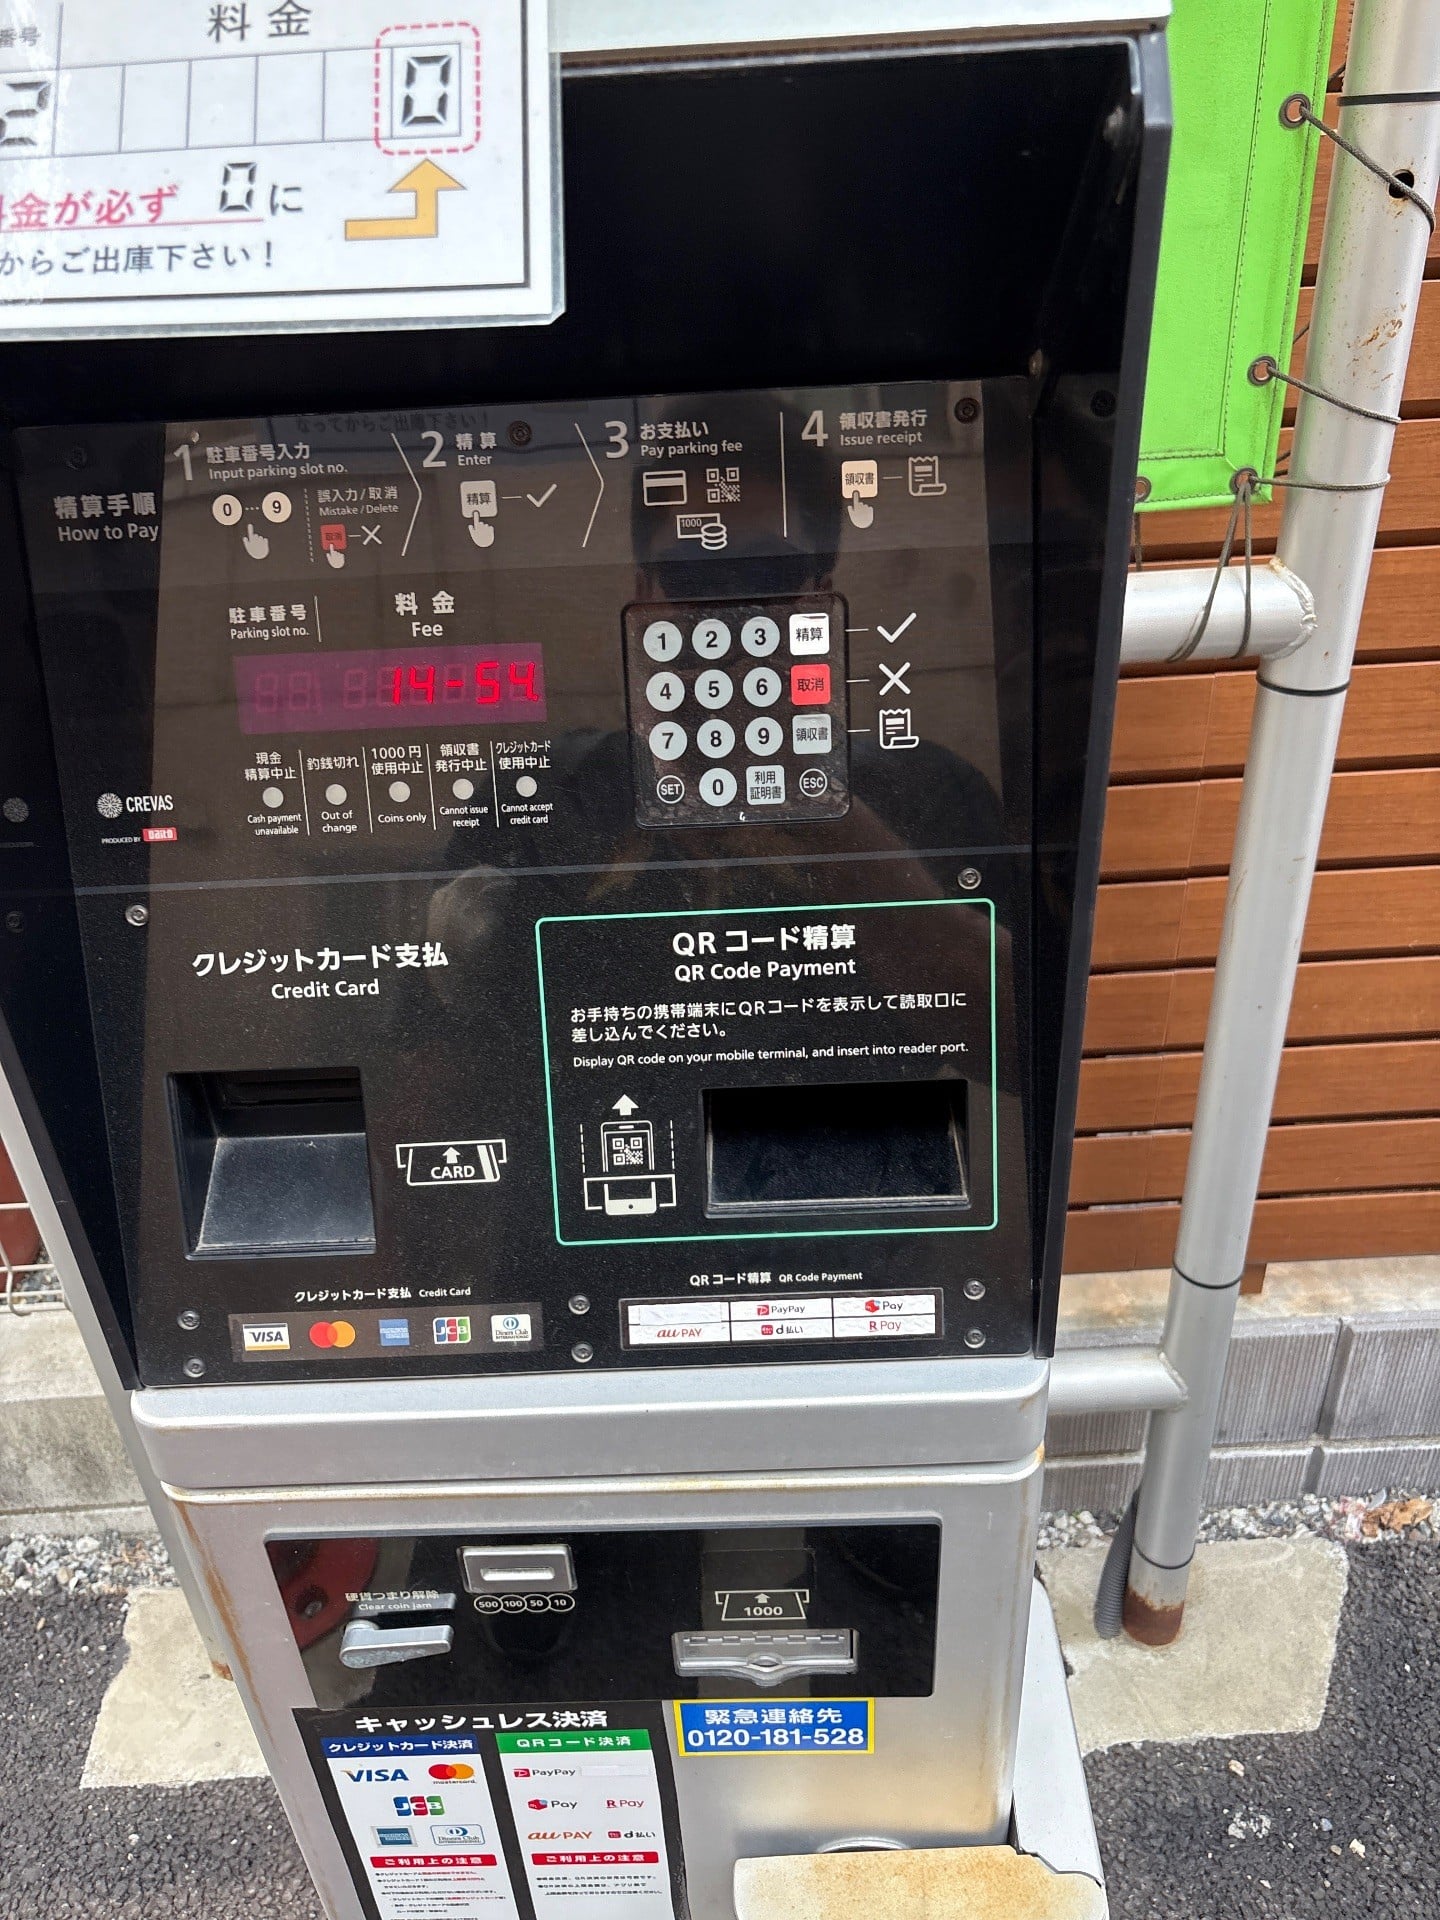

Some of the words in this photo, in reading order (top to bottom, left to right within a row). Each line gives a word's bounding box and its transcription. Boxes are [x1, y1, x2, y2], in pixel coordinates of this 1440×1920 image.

[207, 0, 313, 43] 料金
[401, 55, 452, 125] 0
[0, 81, 52, 146] 2
[0, 184, 179, 229] 金が必ず
[840, 410, 928, 430] 領収書発行
[640, 421, 709, 441] お支払い
[801, 410, 828, 448] 4
[456, 432, 497, 450] 精算
[604, 420, 629, 459] 3
[840, 434, 872, 447] Issue
[873, 431, 922, 447] receipt
[206, 442, 310, 463] 駐車番号入力
[421, 431, 447, 468] 2
[641, 443, 664, 458] Pay
[667, 441, 719, 458] parking
[721, 440, 743, 453] fee
[173, 444, 193, 481] 1
[458, 454, 492, 466] Enter
[209, 467, 244, 481] Input
[247, 465, 296, 480] parking
[300, 463, 324, 475] slot
[327, 463, 348, 473] no.
[844, 471, 875, 486] 領収書
[54, 492, 157, 519] 精算手順
[466, 492, 492, 505] 精算
[223, 503, 232, 516] 0
[272, 500, 281, 514] 9
[680, 518, 702, 528] 1000
[58, 526, 99, 542] How
[104, 524, 122, 540] to
[128, 523, 159, 542] Pay
[395, 590, 455, 617] 料金
[229, 604, 307, 625] 駐車番号
[230, 627, 269, 640] Parking
[271, 626, 291, 638] slot
[293, 626, 309, 637] no.
[412, 622, 443, 638] Fee
[754, 629, 766, 645] 3
[795, 627, 824, 641] 精算
[657, 633, 666, 650] 1
[705, 631, 718, 648] 2
[659, 683, 671, 700] 4
[708, 681, 720, 698] 5
[756, 679, 768, 695] 6
[796, 678, 824, 692] 取消
[661, 733, 673, 749] 7
[710, 731, 722, 748] 8
[758, 728, 770, 745] 9
[796, 727, 829, 742] 領収書
[440, 743, 479, 757] 領収書
[495, 740, 551, 754] クレジットカード
[256, 751, 282, 765] 現金
[307, 756, 360, 771] 釣銭切れ
[435, 758, 487, 773] 発行中止
[498, 755, 551, 770] 使用中止
[245, 766, 297, 781] 精算中止
[372, 760, 424, 775] 使用中止
[754, 771, 776, 784] 利用
[803, 777, 824, 789] ESC
[660, 784, 681, 796] SET
[712, 779, 724, 795] 0
[750, 787, 782, 800] 証明書
[126, 795, 173, 812] CREVAS
[440, 805, 466, 815] Cannot
[468, 804, 488, 814] issue
[501, 803, 528, 813] Cannot
[529, 802, 553, 813] accept
[247, 814, 266, 825] Cash
[268, 813, 302, 826] payment
[321, 811, 341, 821] Out
[343, 810, 353, 821] of
[378, 813, 403, 823] Coins
[405, 812, 427, 825] only
[452, 817, 480, 828] receipt
[510, 815, 531, 825] credit
[533, 814, 548, 824] card
[255, 825, 299, 836] unavailable
[322, 823, 357, 835] change
[192, 942, 449, 977] クレジットカード支払
[674, 965, 705, 982] QR
[710, 961, 761, 981] Code
[767, 958, 856, 981] Payment
[271, 980, 330, 999] Credit
[334, 978, 379, 997] Card
[570, 991, 967, 1024] お手持ちの携帯端末にQRコードを表示して読取口に
[571, 1021, 727, 1043] 差し込んでください。
[573, 1055, 614, 1069] Display
[617, 1053, 635, 1066] QR
[637, 1052, 666, 1064] code
[668, 1053, 683, 1064] on
[686, 1052, 713, 1065] your
[716, 1047, 755, 1061] mobile
[757, 1046, 809, 1061] terminal,
[811, 1044, 834, 1057] and
[837, 1043, 869, 1056] insert
[872, 1043, 895, 1055] into
[898, 1042, 936, 1055] reader
[940, 1041, 969, 1055] port.
[431, 1165, 475, 1179] CARD
[778, 1273, 794, 1283] QR
[795, 1272, 820, 1283] Code
[822, 1271, 863, 1282] Payment
[294, 1287, 411, 1303] クレジットカード支払
[419, 1287, 447, 1298] Credit
[449, 1286, 471, 1297] Card
[771, 1304, 805, 1315] PayPay
[883, 1300, 903, 1312] Pay
[434, 1321, 469, 1339] JCB
[657, 1328, 680, 1338] au
[682, 1328, 702, 1337] PAY
[869, 1321, 877, 1332] R
[880, 1320, 902, 1332] Pay
[249, 1330, 283, 1343] VISA
[358, 1603, 385, 1611] Clear
[388, 1602, 410, 1610] coin
[412, 1601, 432, 1611] jam
[479, 1601, 499, 1609] 500
[504, 1600, 523, 1608] 100
[530, 1599, 543, 1608] 50
[553, 1598, 566, 1607] 10
[743, 1606, 783, 1617] 1000
[355, 1710, 608, 1734] キャッシュレス決済
[705, 1708, 842, 1725] 緊急連絡先
[517, 1736, 631, 1749] QRコード決済
[688, 1728, 864, 1747] 0120-181-528
[329, 1739, 473, 1754] クレジットカード決済
[342, 1768, 409, 1783] VISA
[532, 1767, 576, 1778] PayPay
[395, 1799, 444, 1813] JCB
[552, 1799, 577, 1810] Pay
[606, 1800, 615, 1809] R
[620, 1798, 645, 1809] Pay
[528, 1831, 561, 1840] au
[564, 1831, 592, 1839] PAY
[385, 1856, 482, 1866] ご利用上の注意
[546, 1854, 645, 1863] ご利用上の注意
